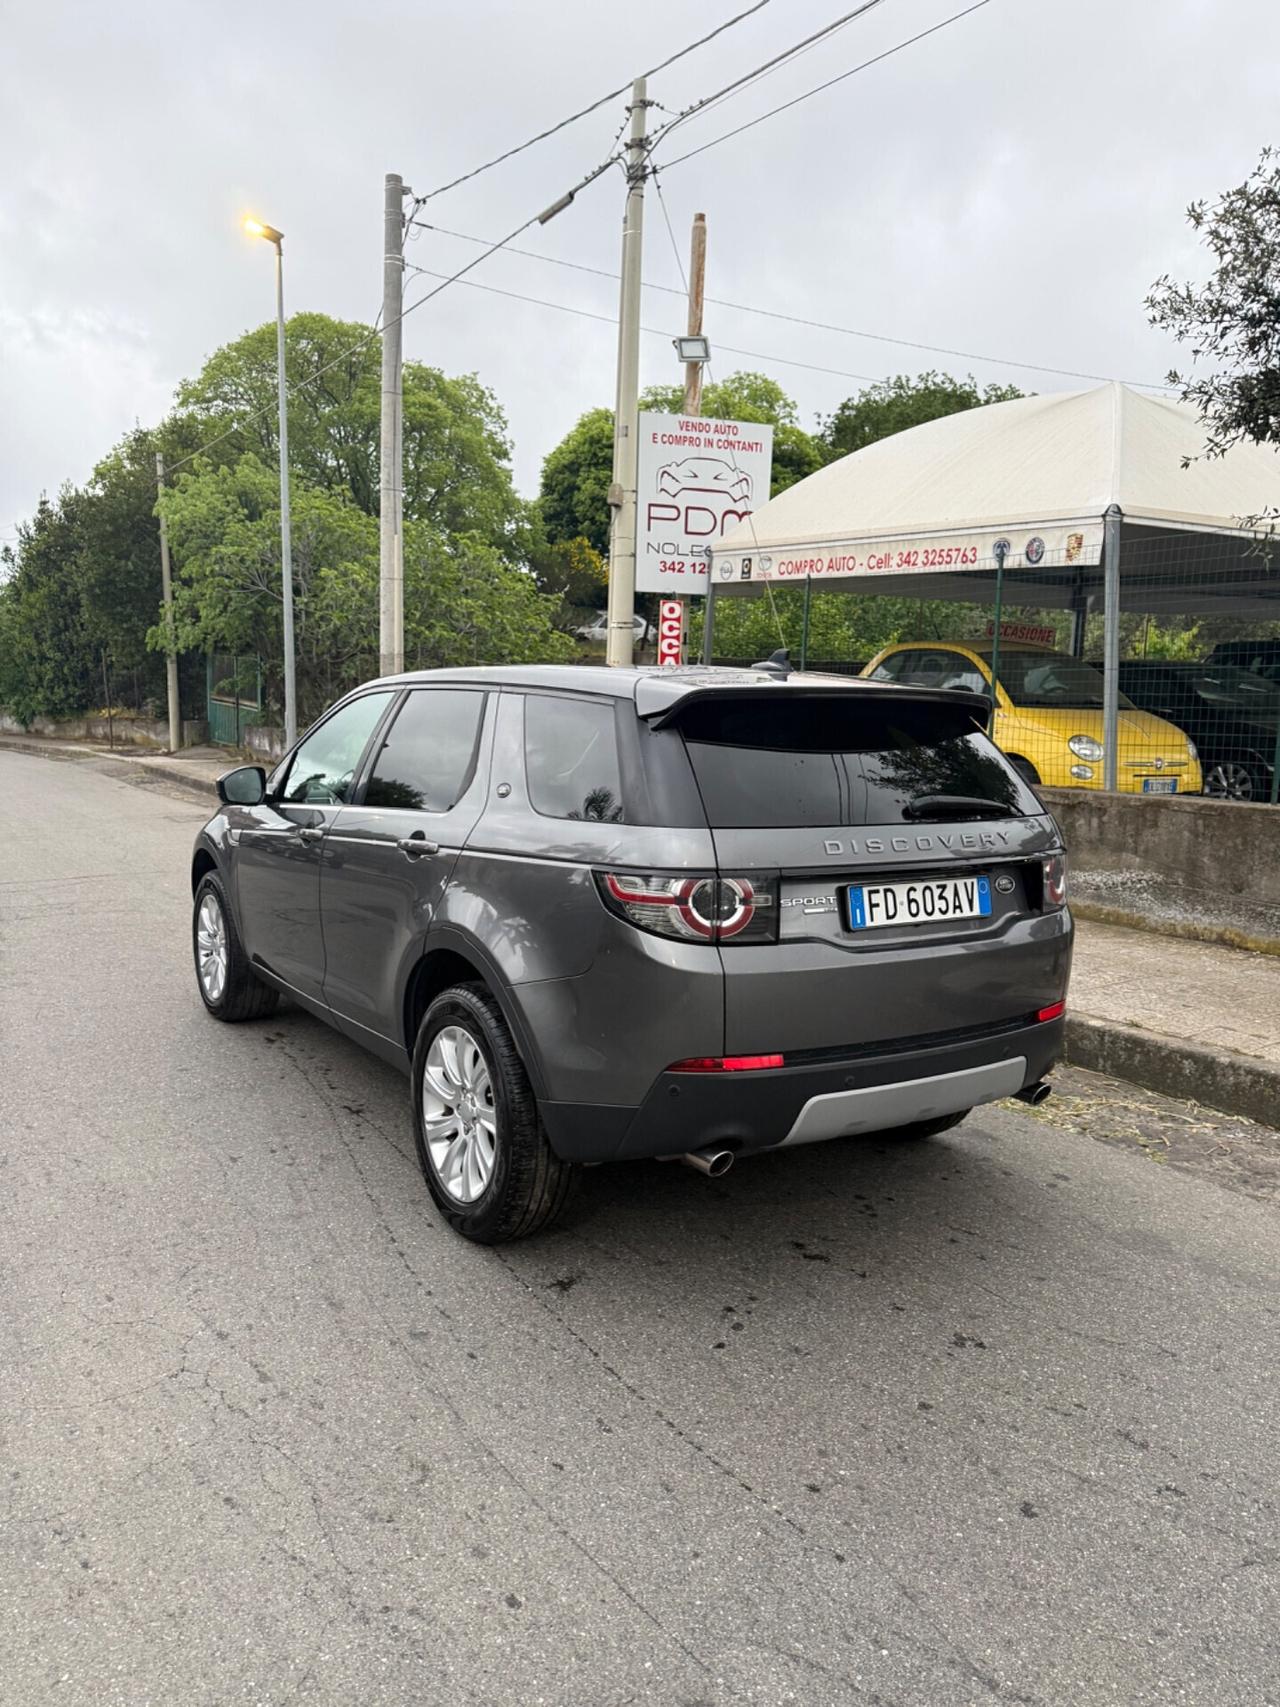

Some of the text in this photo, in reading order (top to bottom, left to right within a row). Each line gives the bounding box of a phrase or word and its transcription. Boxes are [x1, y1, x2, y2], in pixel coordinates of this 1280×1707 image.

[678, 420, 739, 436] VENDO AUTO
[652, 432, 763, 453] E COMPRO IN CONTANTI
[659, 560, 686, 573] 342
[690, 562, 711, 575] 12
[778, 557, 823, 576] COMPRO
[827, 555, 857, 573] AUTO
[867, 552, 894, 570] Cell:
[897, 550, 919, 568] 342
[922, 546, 978, 566] 3255763
[824, 831, 1010, 856] DISCOVERY
[780, 896, 837, 907] SPORT
